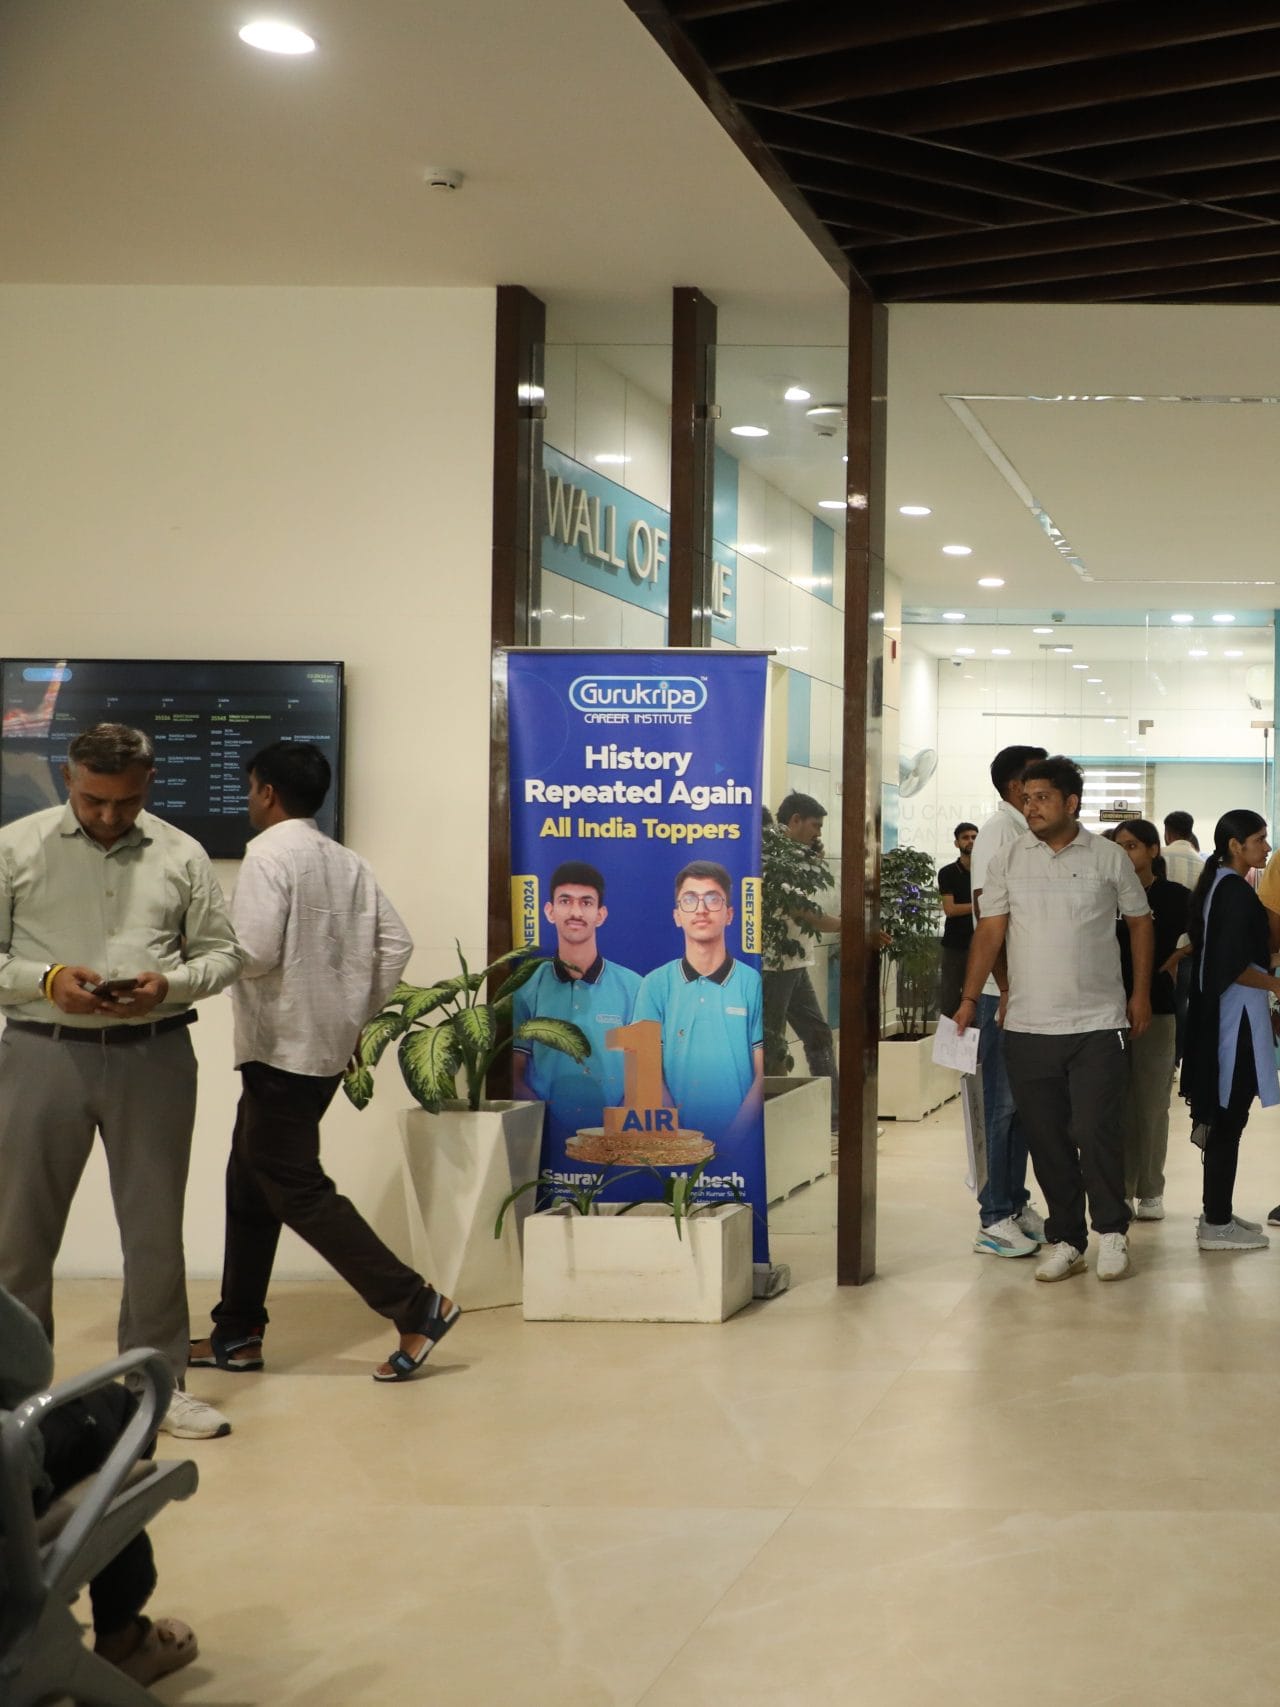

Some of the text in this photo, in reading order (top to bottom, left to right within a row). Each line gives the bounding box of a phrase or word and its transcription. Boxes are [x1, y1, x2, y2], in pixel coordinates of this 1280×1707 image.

[545, 468, 626, 569] WALL
[628, 519, 669, 584] OF
[580, 682, 696, 710] Gurukripa
[584, 714, 693, 724] CAREER INSTITUTE
[585, 744, 693, 777] History
[524, 779, 753, 811] Repeated Again
[539, 817, 741, 844] All India Toppers
[524, 879, 535, 948] NEET-2024
[745, 882, 755, 950] NEET-2025
[622, 1109, 675, 1132] AIR
